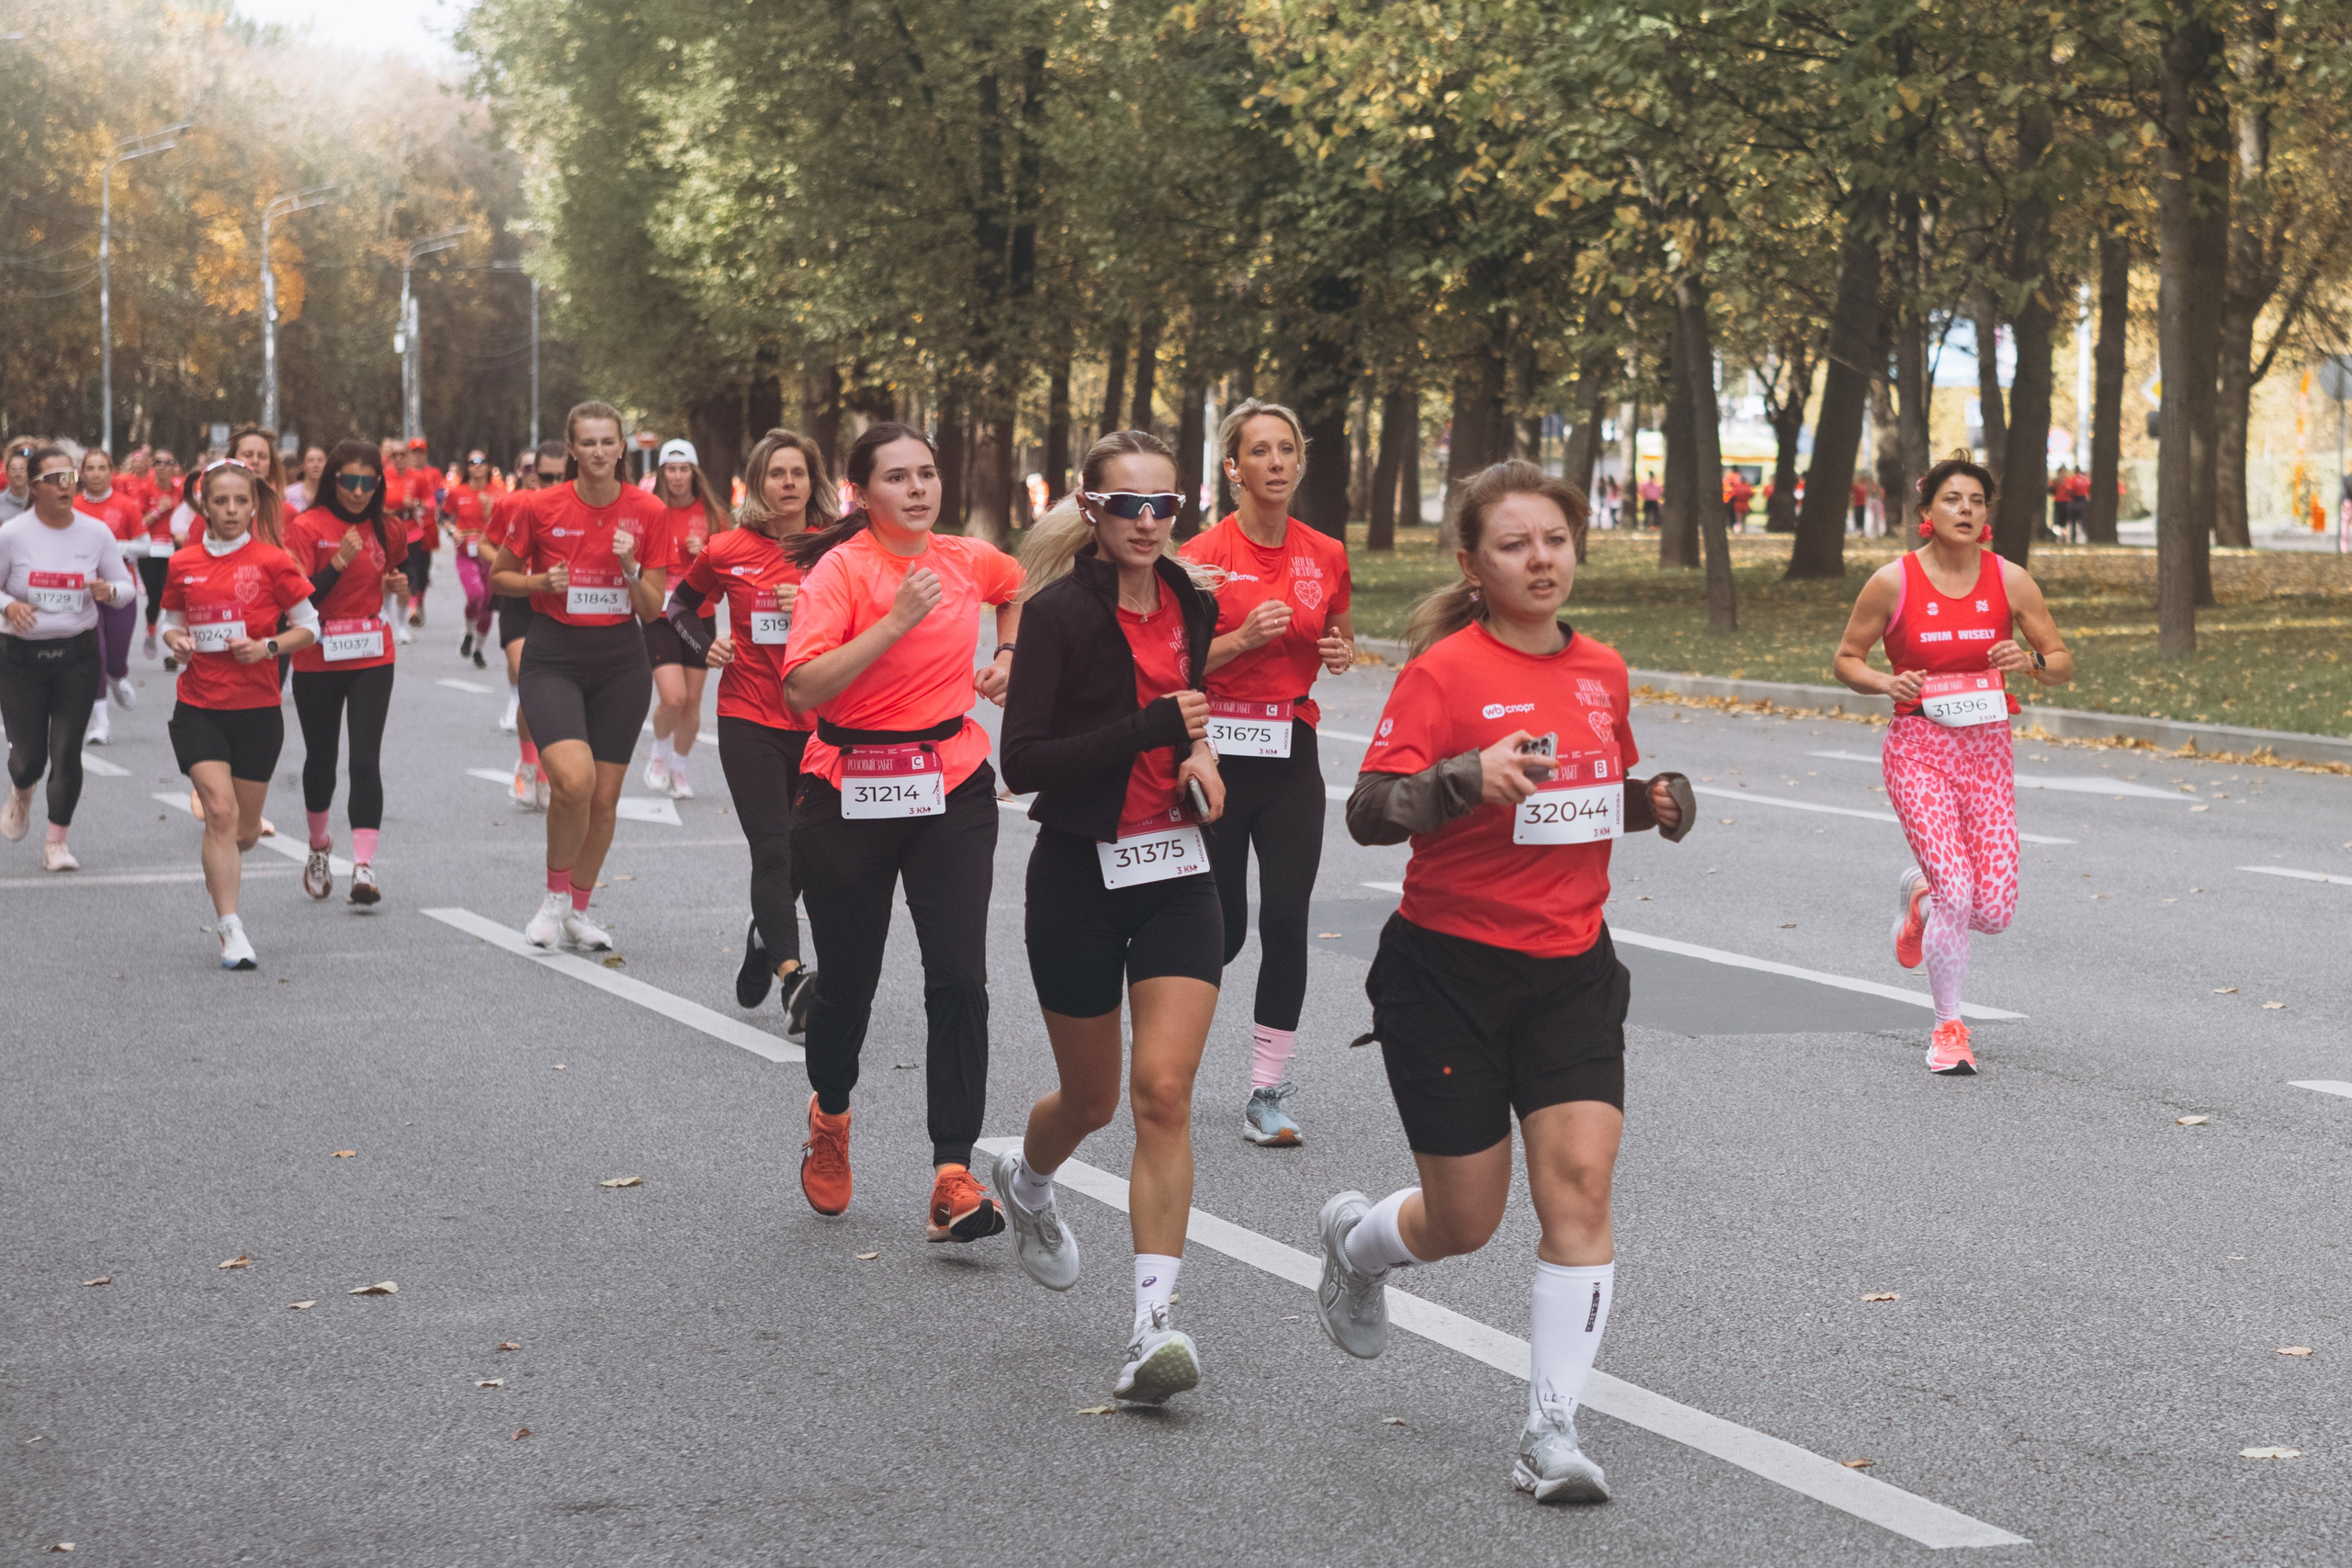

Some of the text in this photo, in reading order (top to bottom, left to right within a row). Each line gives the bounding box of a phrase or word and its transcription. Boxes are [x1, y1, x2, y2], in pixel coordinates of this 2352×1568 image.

[35, 592, 71, 604] 31729
[573, 592, 618, 604] 31843
[760, 618, 791, 632] 319
[1920, 628, 1996, 643] SWIM WISELY
[331, 638, 370, 651] 31037
[1268, 705, 1276, 714] C
[1484, 703, 1535, 717] wb спорт
[1932, 698, 1988, 717] 31396
[1212, 725, 1272, 742] 31675
[913, 757, 922, 766] C
[854, 784, 920, 803] 31214
[1170, 807, 1180, 818] C
[1524, 797, 1609, 824] 32044
[1593, 829, 1599, 838] 3
[1114, 839, 1185, 868] 31375
[1195, 833, 1204, 863] МОСКВА
[1176, 866, 1182, 874] 3
[1544, 1393, 1573, 1406] LET
